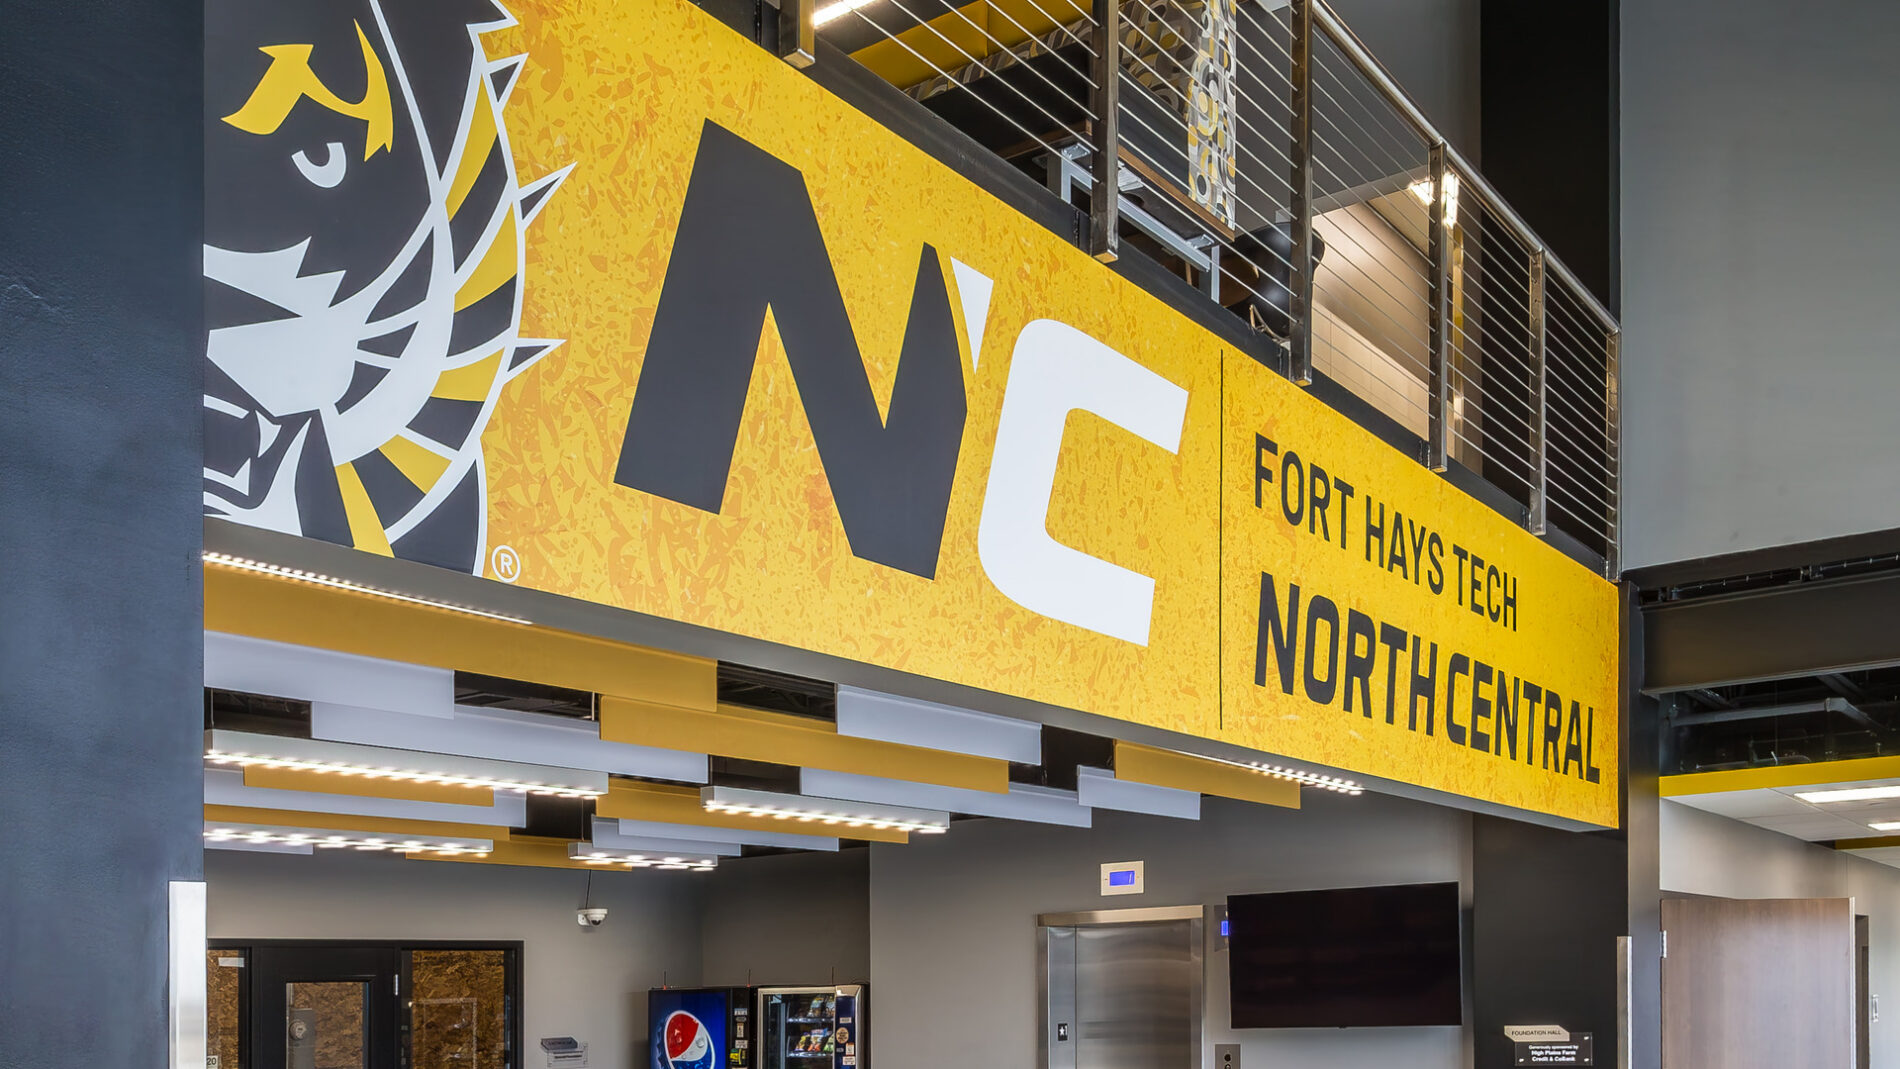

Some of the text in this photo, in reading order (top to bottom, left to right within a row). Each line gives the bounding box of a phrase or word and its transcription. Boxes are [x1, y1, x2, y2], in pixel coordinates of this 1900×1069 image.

[1254, 431, 1517, 632] FORT HAYS TECH
[1254, 570, 1601, 784] NORTH CENTRAL
[206, 1057, 217, 1065] 20
